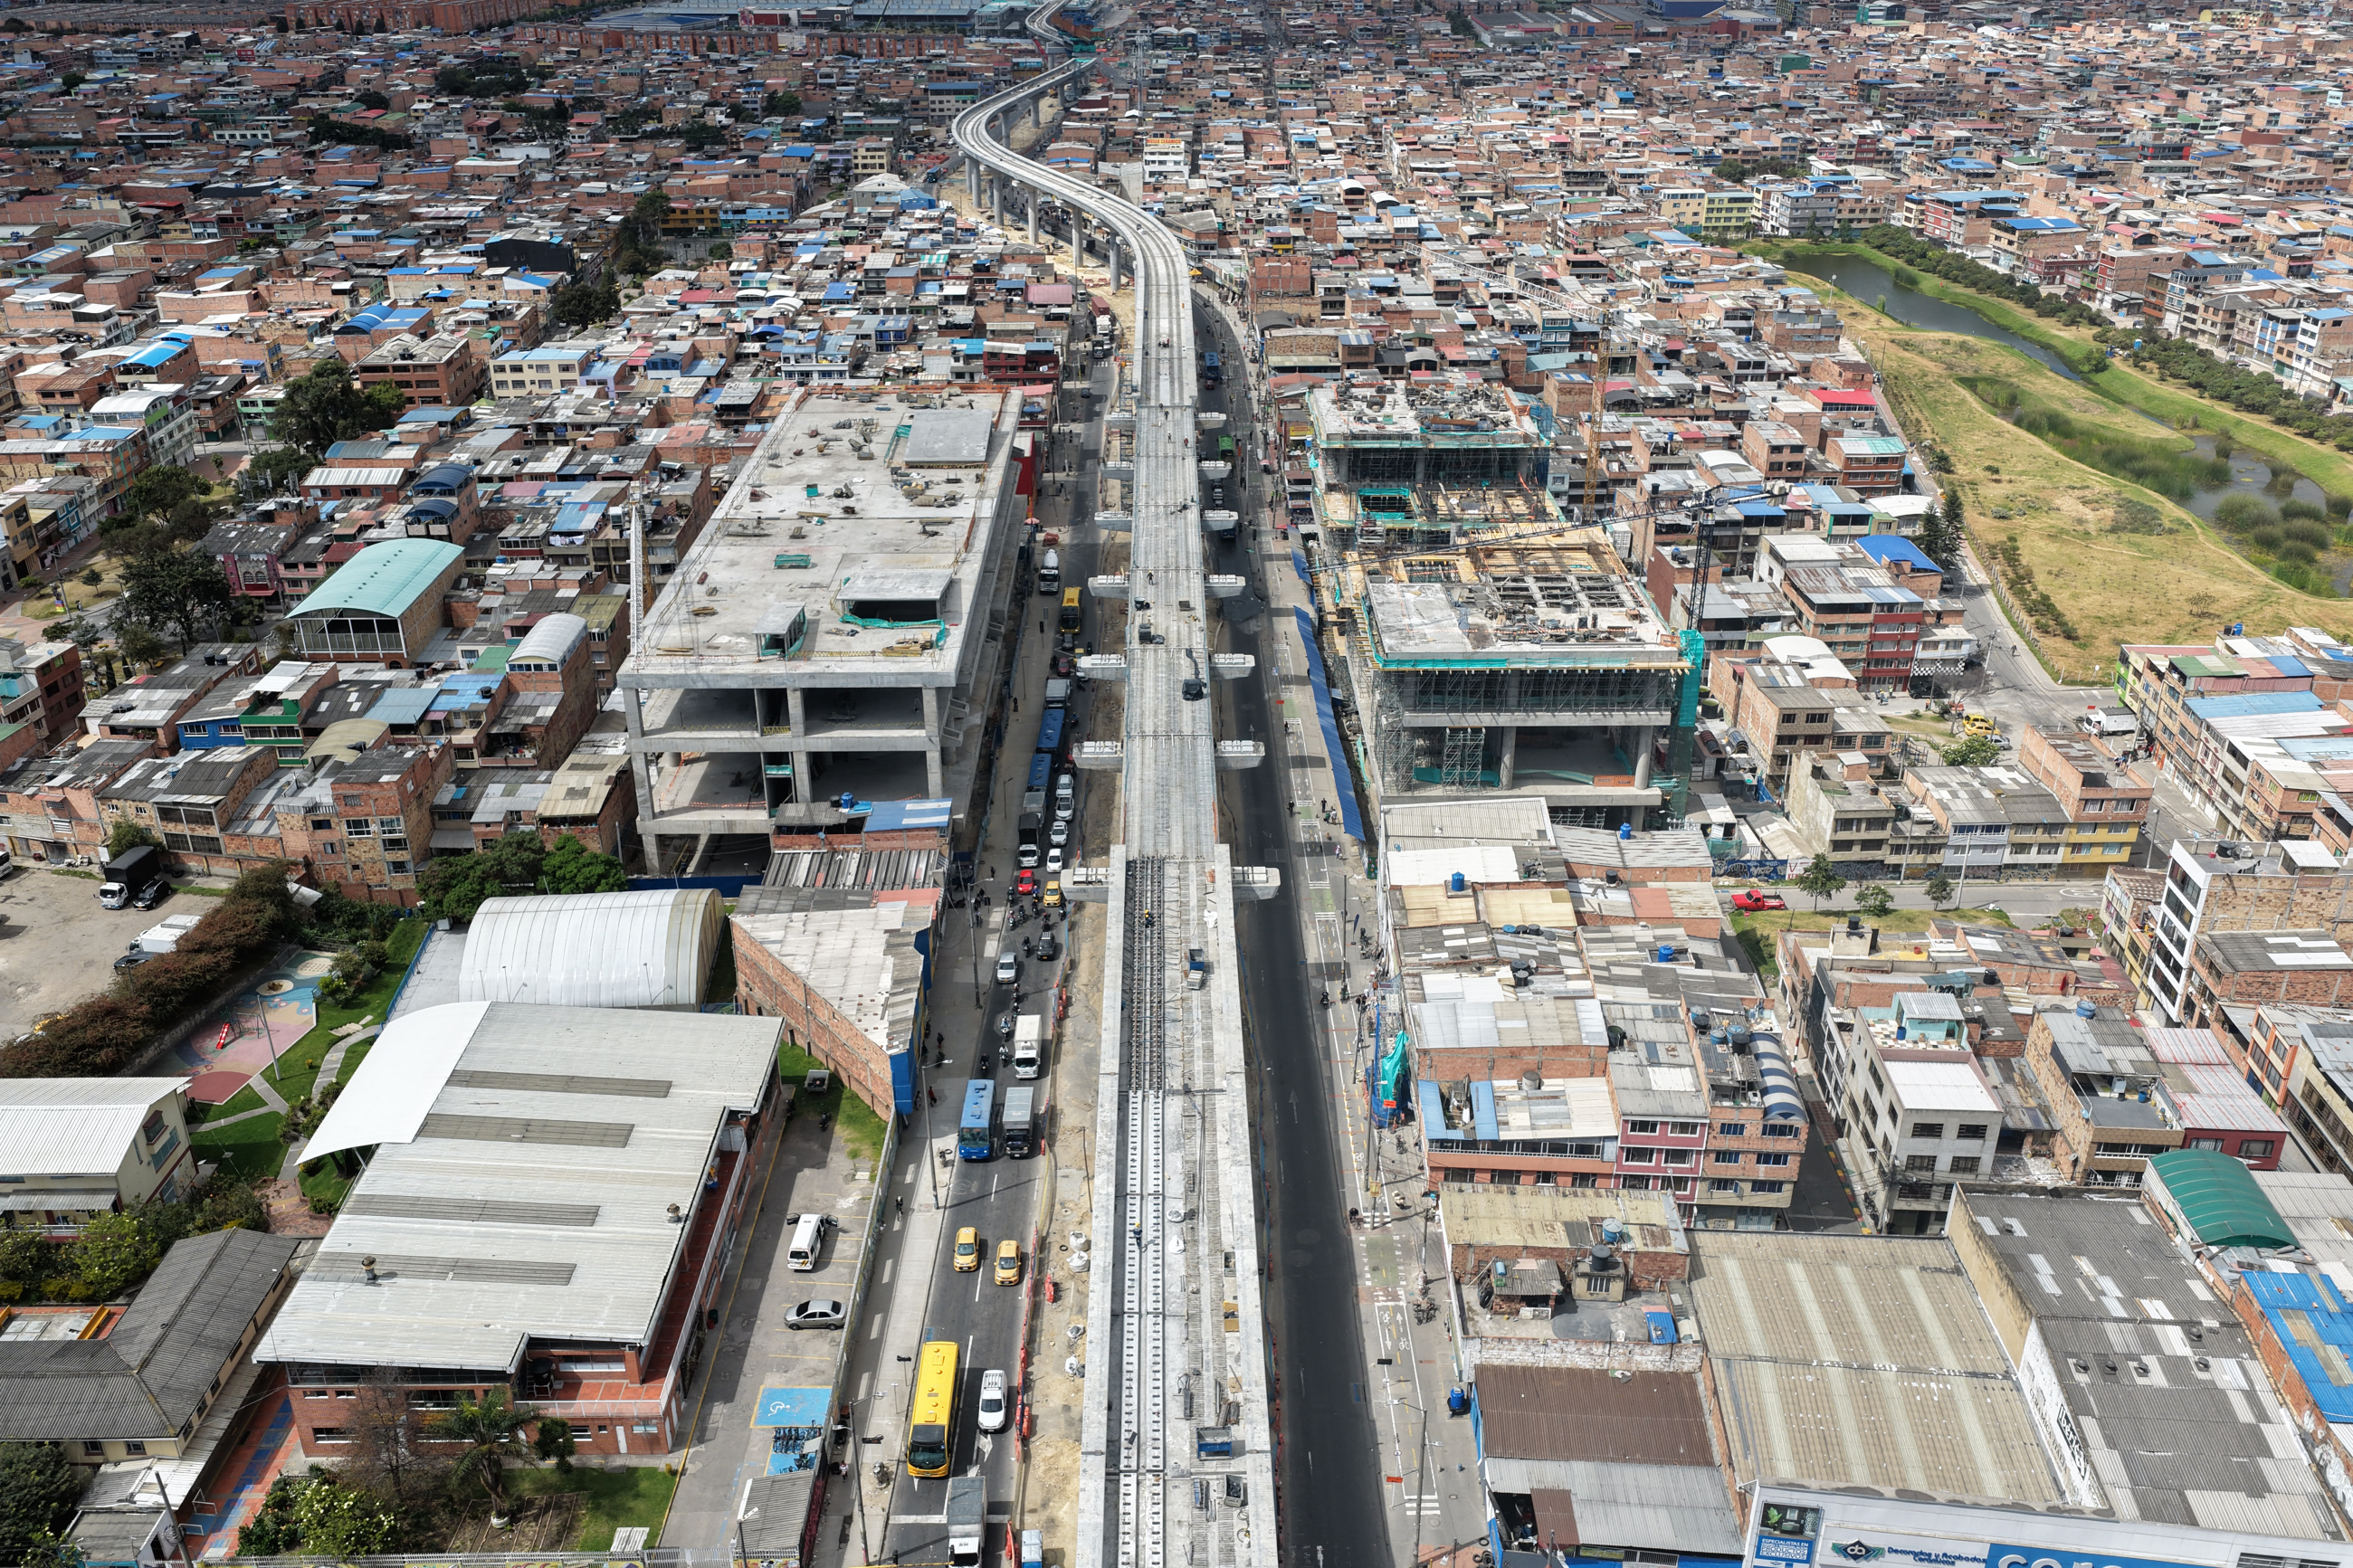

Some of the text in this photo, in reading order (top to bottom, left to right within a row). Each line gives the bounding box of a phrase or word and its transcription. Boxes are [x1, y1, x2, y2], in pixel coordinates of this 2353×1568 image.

[1762, 1538, 1800, 1546] ESPECIALISTAS
[1761, 1545, 1807, 1554] PRODUCTOS
[1760, 1551, 1806, 1560] EXCLUSIVOS
[1941, 1553, 1987, 1564] Acabados
